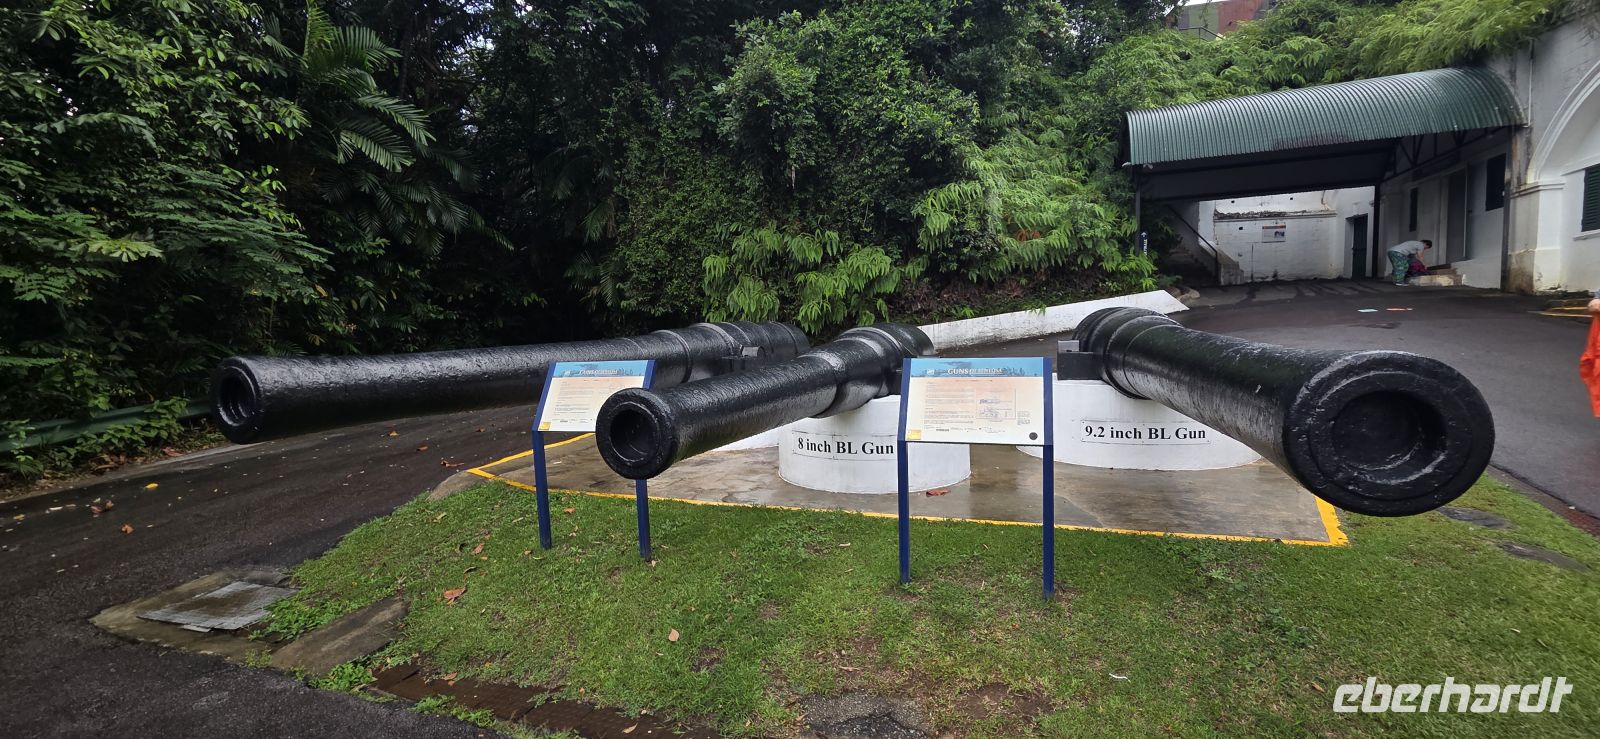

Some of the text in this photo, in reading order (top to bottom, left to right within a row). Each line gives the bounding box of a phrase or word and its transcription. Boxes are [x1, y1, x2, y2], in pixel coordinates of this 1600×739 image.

[1085, 425, 1206, 440] 9.2 inch BL Gun
[798, 437, 894, 455] 8 inch BL Gun
